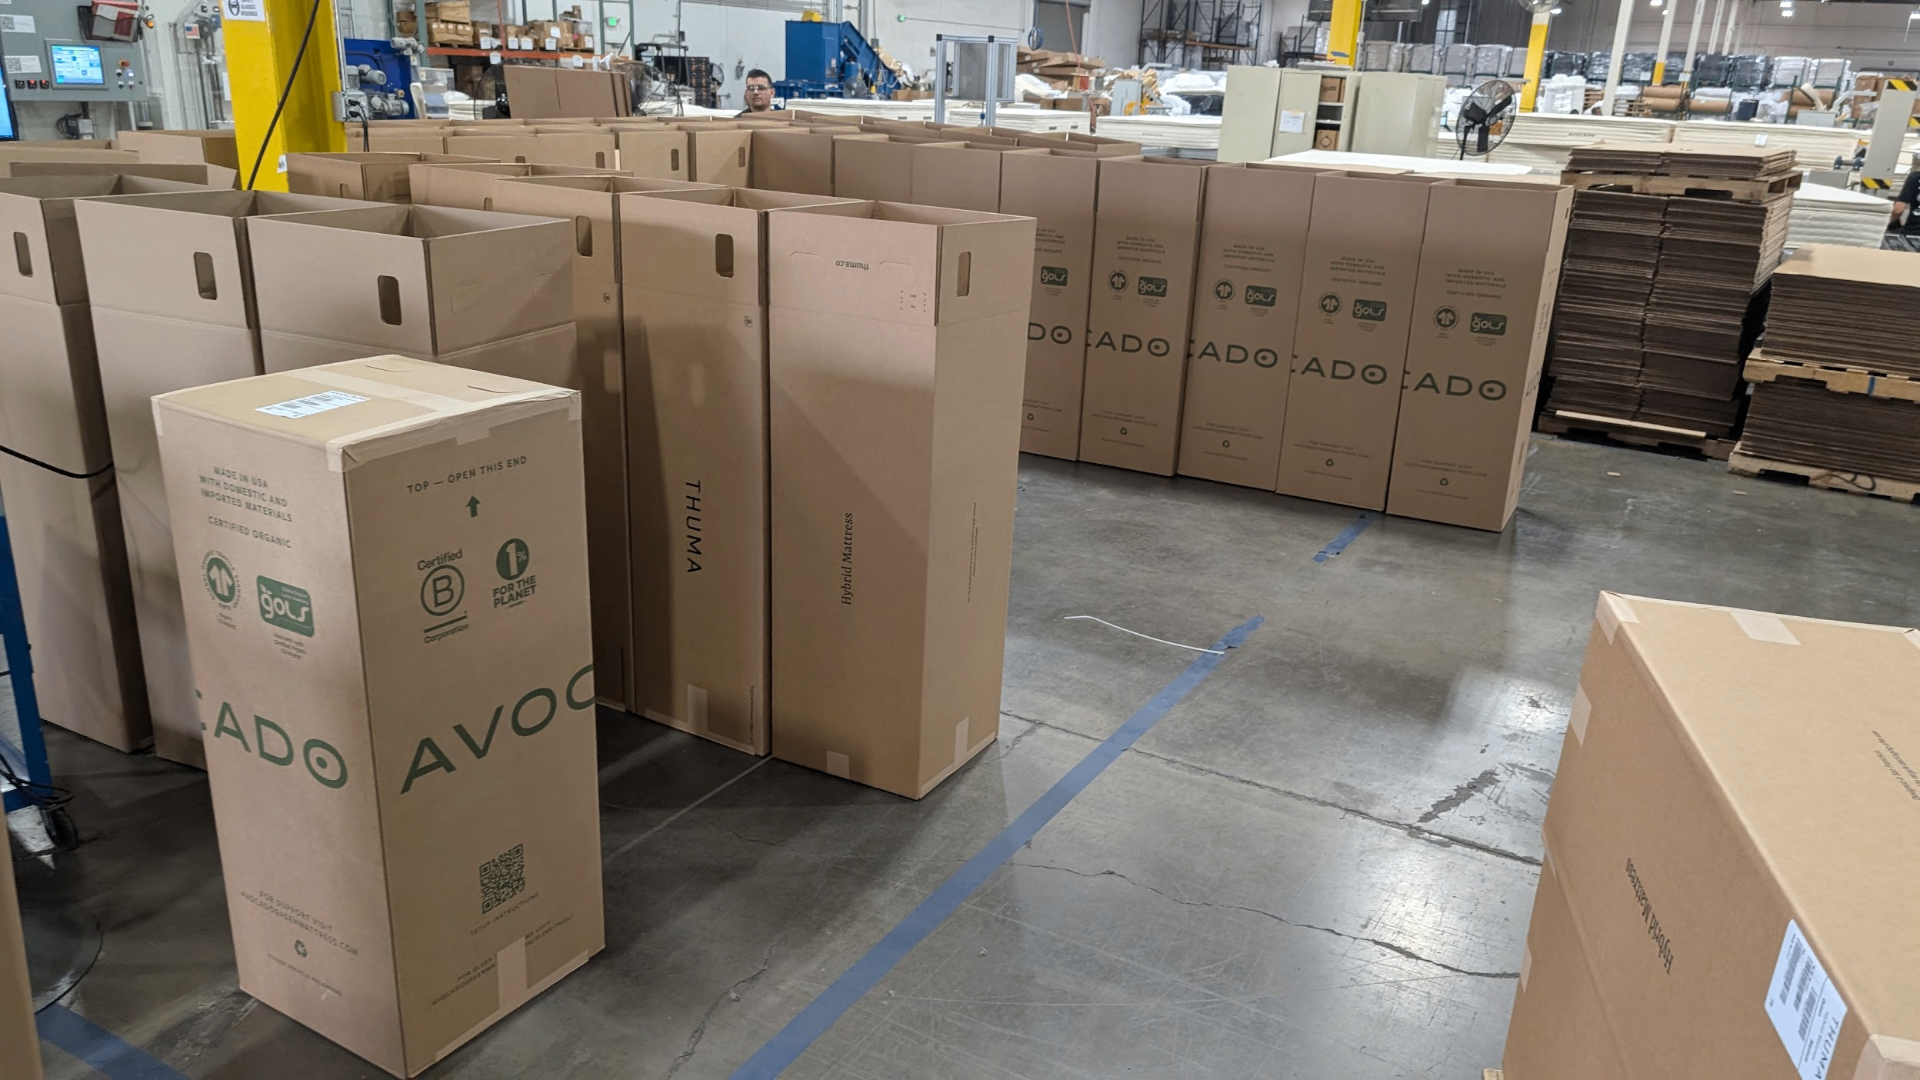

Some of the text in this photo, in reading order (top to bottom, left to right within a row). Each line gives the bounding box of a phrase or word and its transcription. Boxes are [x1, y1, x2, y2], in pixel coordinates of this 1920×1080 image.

[835, 260, 869, 271] thuma.co
[199, 474, 288, 507] WITH DOMESTIC AND
[213, 466, 268, 489] MADE IN USA
[406, 481, 429, 494] TOP
[447, 469, 476, 484] OPEN
[479, 461, 503, 476] THIS
[506, 456, 527, 469] END
[200, 488, 293, 522] IMPORTED MATERIALS
[208, 515, 292, 549] CERTIFIED ORGANIC
[685, 480, 702, 572] THUMA
[417, 548, 463, 571] Certified
[841, 512, 853, 605] Hybrid Mattress
[431, 575, 454, 608] B
[493, 575, 537, 599] FOR THE
[493, 585, 537, 608] PLANET
[423, 622, 469, 644] Corporation
[196, 688, 348, 789] ADO
[1626, 858, 1674, 975] Hybrid Mattress
